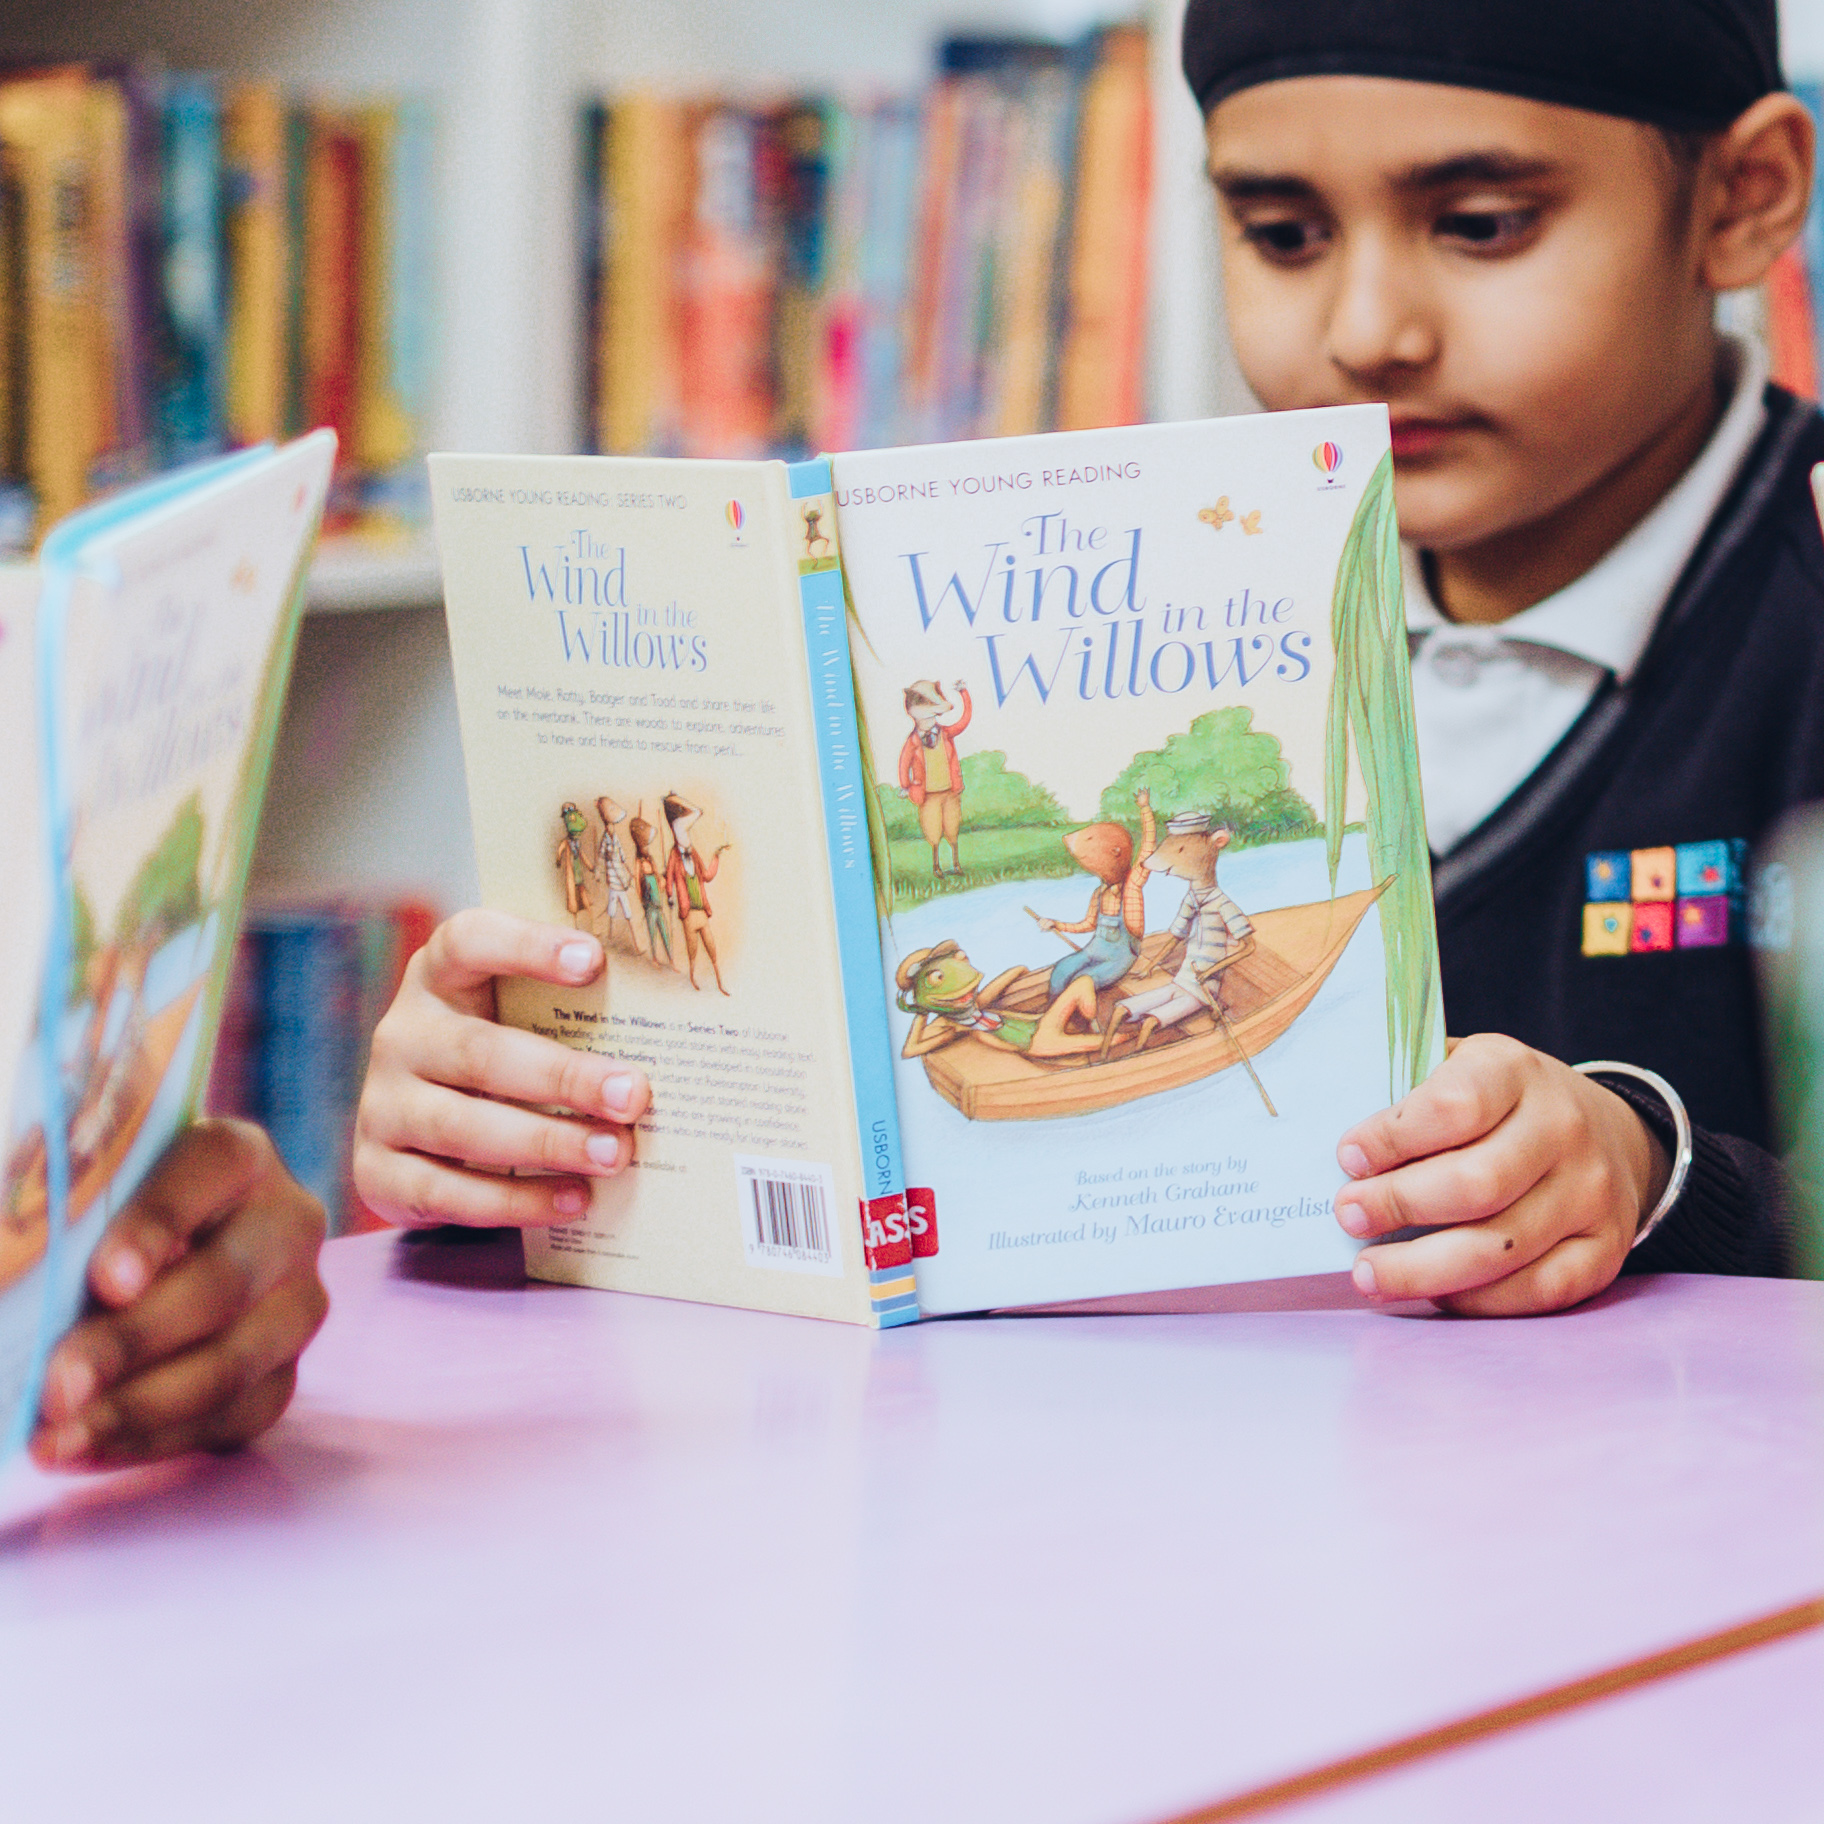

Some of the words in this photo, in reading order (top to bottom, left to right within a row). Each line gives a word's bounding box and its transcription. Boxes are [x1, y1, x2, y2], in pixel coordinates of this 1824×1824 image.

[452, 487, 505, 504] USBORNE
[509, 488, 553, 505] YOUNG
[617, 492, 655, 509] SERIES
[658, 494, 688, 510] TWO
[836, 480, 939, 507] USBORNE
[948, 472, 1033, 496] YOUNG
[1042, 461, 1142, 487] READING
[570, 529, 610, 560] The
[1021, 508, 1108, 557] The
[516, 545, 629, 607] Wind
[897, 527, 1148, 633] Wind
[635, 603, 658, 627] in
[664, 600, 698, 628] the
[815, 600, 836, 635] The
[1160, 601, 1209, 634] in
[1223, 587, 1295, 628] the
[555, 609, 708, 672] Willows
[821, 649, 845, 708] Wind
[975, 618, 1312, 710] Willows
[497, 684, 522, 699] Meet
[589, 690, 624, 708] Badger
[629, 694, 647, 706] and
[650, 693, 676, 708] Toad
[679, 695, 699, 709] and
[702, 697, 729, 711] share
[733, 699, 756, 712] their
[513, 708, 528, 721] the
[583, 710, 611, 725] There
[615, 716, 631, 726] are
[635, 716, 668, 729] woods
[671, 719, 682, 731] to
[729, 723, 786, 737] adventures
[828, 716, 846, 736] in
[538, 732, 548, 744] to
[551, 733, 575, 745] have
[578, 734, 597, 747] and
[600, 733, 633, 749] friends
[636, 739, 647, 751] to
[650, 741, 682, 752] rescue
[686, 740, 710, 754] from
[831, 744, 850, 770] the
[835, 784, 859, 868] Willows
[532, 1023, 558, 1038] Young
[553, 1007, 571, 1021] The
[573, 1010, 597, 1023] Wind
[600, 1013, 609, 1024] in
[612, 1015, 626, 1026] the
[629, 1016, 666, 1030] Willows
[687, 1021, 715, 1034] Series
[719, 1024, 738, 1036] Two
[618, 1049, 656, 1065] Reading
[700, 1057, 741, 1073] developed
[872, 1119, 893, 1195] USBORN
[1074, 1167, 1123, 1186] Based
[1128, 1167, 1149, 1180] on
[1154, 1162, 1178, 1178] the
[1182, 1159, 1222, 1176] story
[1227, 1155, 1249, 1174] by
[1067, 1186, 1158, 1213] Kenneth
[1164, 1180, 1260, 1203] Grahame
[866, 1205, 929, 1249] ASS
[988, 1222, 1086, 1251] Illustrated
[1092, 1222, 1119, 1243] by
[1124, 1212, 1206, 1237] Mauro
[1213, 1196, 1336, 1228] Evangelist
